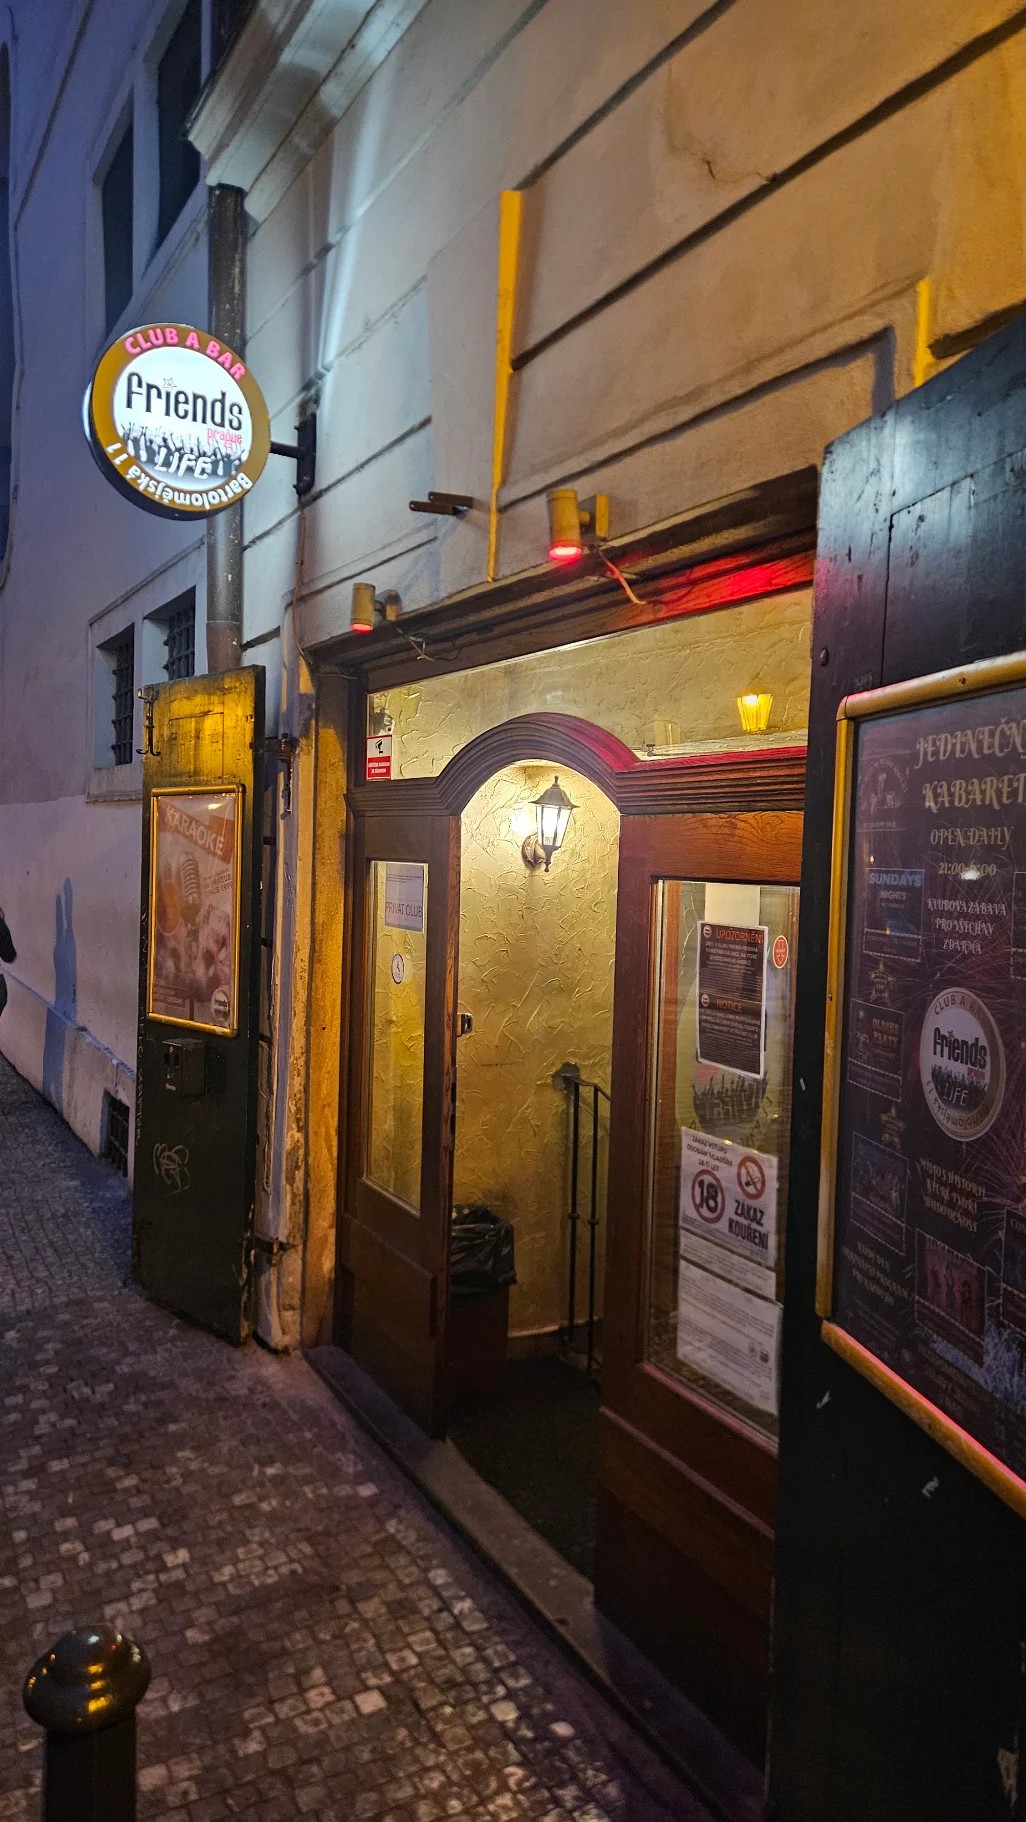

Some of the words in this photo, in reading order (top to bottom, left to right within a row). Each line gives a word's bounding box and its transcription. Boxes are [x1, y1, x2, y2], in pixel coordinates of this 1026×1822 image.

[124, 327, 179, 356] CLUB
[185, 332, 200, 349] A
[205, 340, 247, 380] BAR
[125, 371, 243, 431] friends
[106, 442, 129, 465] 11
[154, 447, 213, 480] LIFE
[126, 465, 253, 510] Bartolomějská
[165, 806, 225, 857] KARAOKE
[930, 827, 965, 847] OPEN
[968, 825, 1014, 851] DAILY
[869, 872, 922, 887] SUNDAYS
[385, 901, 404, 916] PRIVAT
[406, 904, 423, 918] CLUB
[716, 998, 743, 1013] NOTICE
[932, 1026, 988, 1071] friends
[697, 1178, 719, 1214] 18
[734, 1199, 765, 1227] ZÁKAZ
